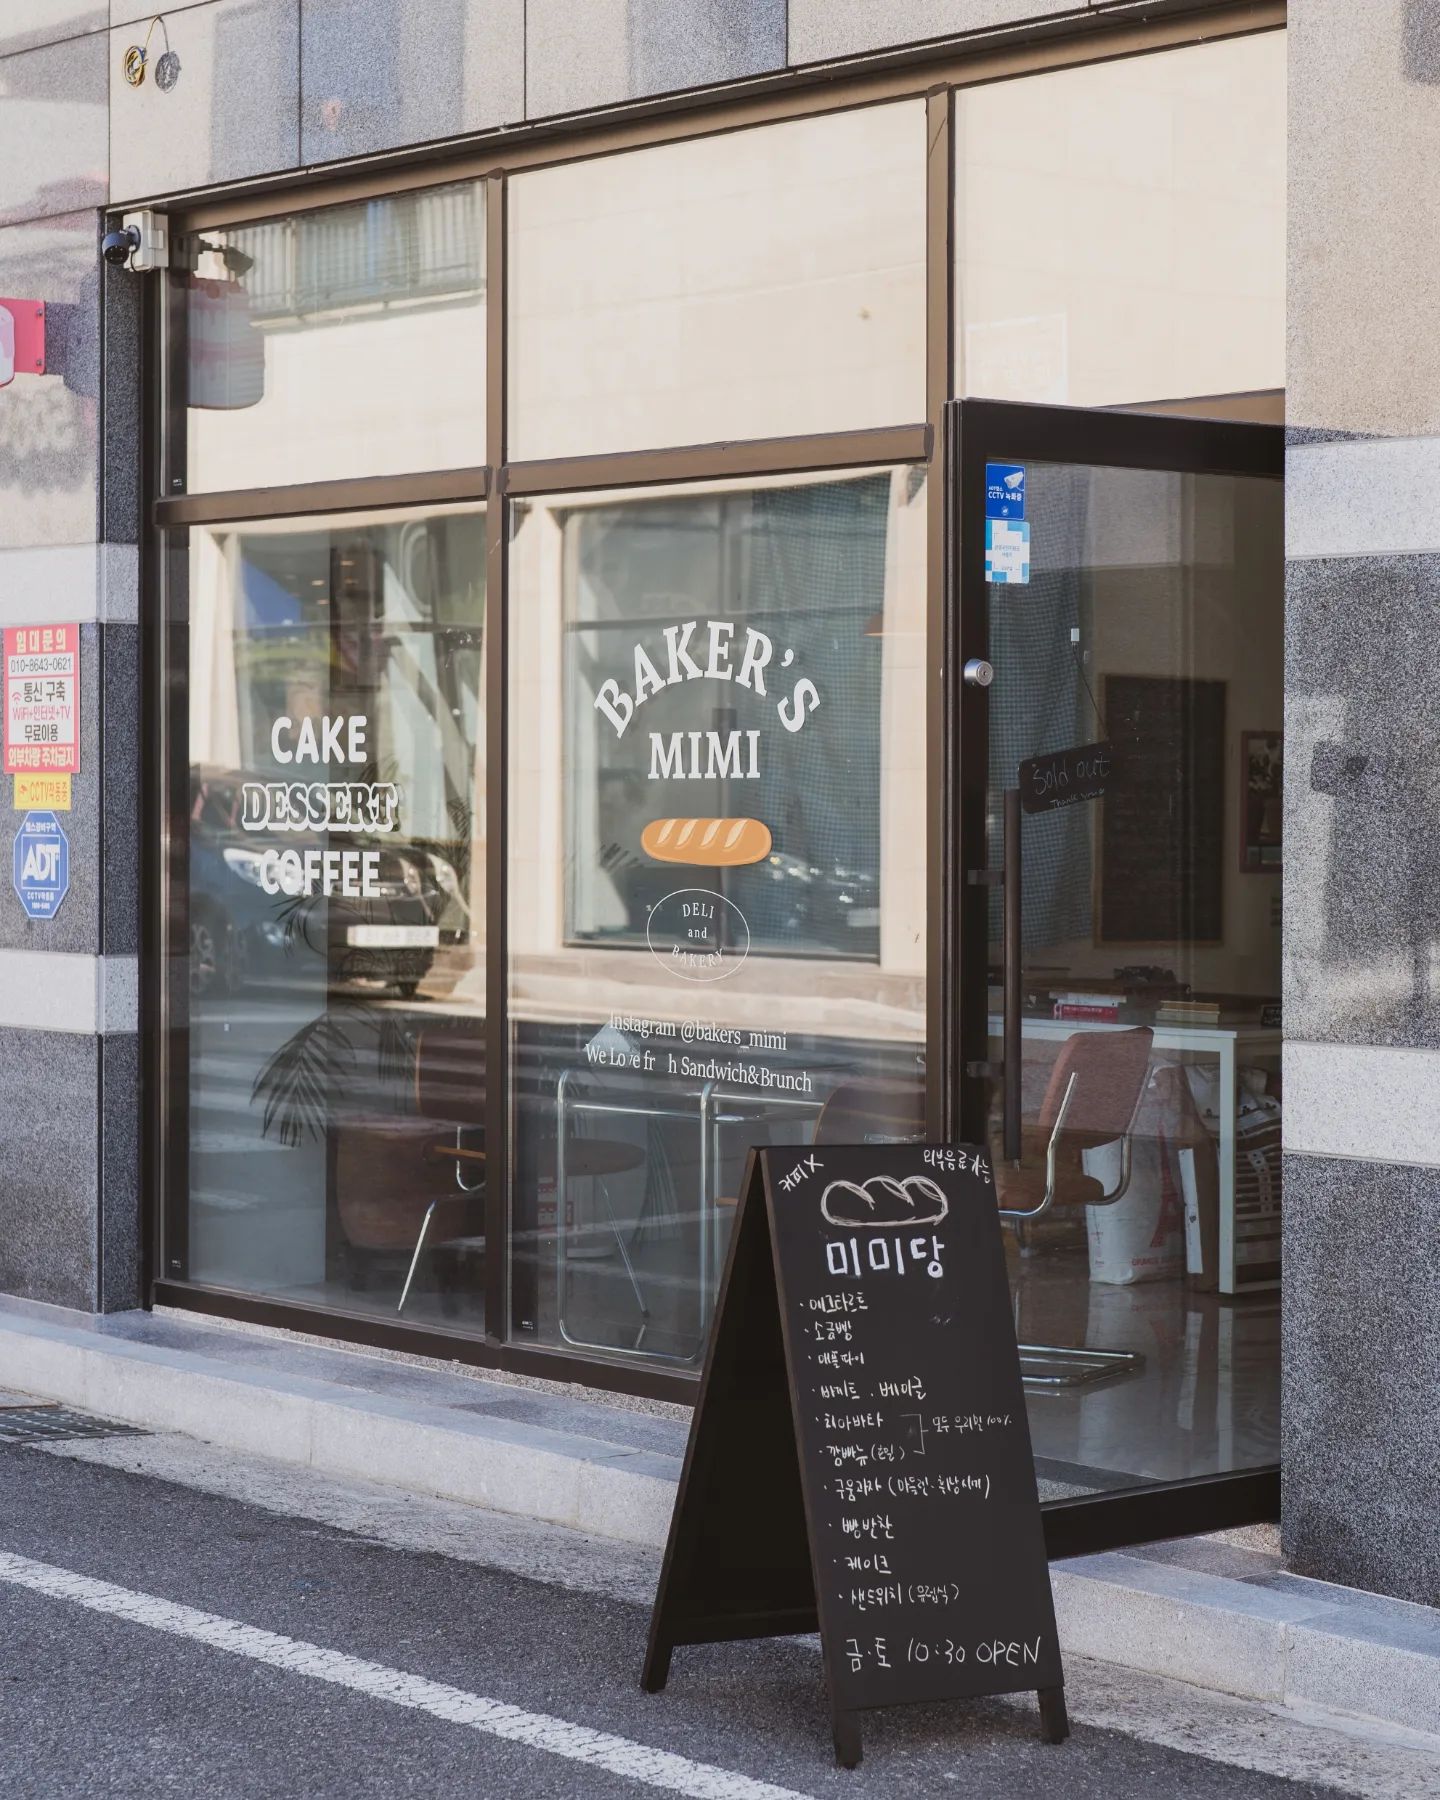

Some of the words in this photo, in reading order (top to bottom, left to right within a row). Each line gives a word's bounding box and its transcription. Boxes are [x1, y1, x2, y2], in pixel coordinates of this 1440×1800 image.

[988, 491, 1004, 500] CCTV
[16, 628, 66, 653] 임대문의
[10, 659, 72, 673] 010-8643-0621
[23, 681, 43, 703] 통신
[46, 681, 66, 702] 구축
[594, 620, 820, 739] BAKER'S
[24, 724, 59, 742] 무료이용
[271, 715, 367, 764] CAKE
[8, 747, 41, 767] 외부차량
[42, 746, 74, 767] 주차금지
[648, 730, 761, 780] MIMI
[1032, 759, 1069, 795] Sold
[1076, 754, 1111, 779] out
[242, 782, 399, 832] DESSERT
[22, 843, 59, 881] ADT
[259, 849, 381, 897] COFFEE
[682, 902, 715, 919] DELI
[688, 927, 707, 939] and
[671, 944, 724, 968] BAKERY
[610, 1011, 677, 1038] Instagram
[680, 1018, 788, 1051] @bakers_mimi
[586, 1043, 607, 1065] We
[643, 1050, 678, 1075] frh
[681, 1058, 813, 1093] Sandwich&Brunch
[826, 1236, 945, 1279] 미미당
[809, 1292, 869, 1314] 에그타르트
[814, 1320, 853, 1341] 소금빵
[878, 1375, 927, 1400] 베이글
[824, 1411, 884, 1431] 치아바타
[932, 1416, 950, 1433] 모두
[954, 1414, 983, 1434] 우리밀
[834, 1476, 882, 1502] 구움과자
[845, 1554, 892, 1575] 케이크
[851, 1582, 902, 1611] 샌드위치
[907, 1637, 966, 1664] 10:30
[976, 1636, 1041, 1667] OPEN
